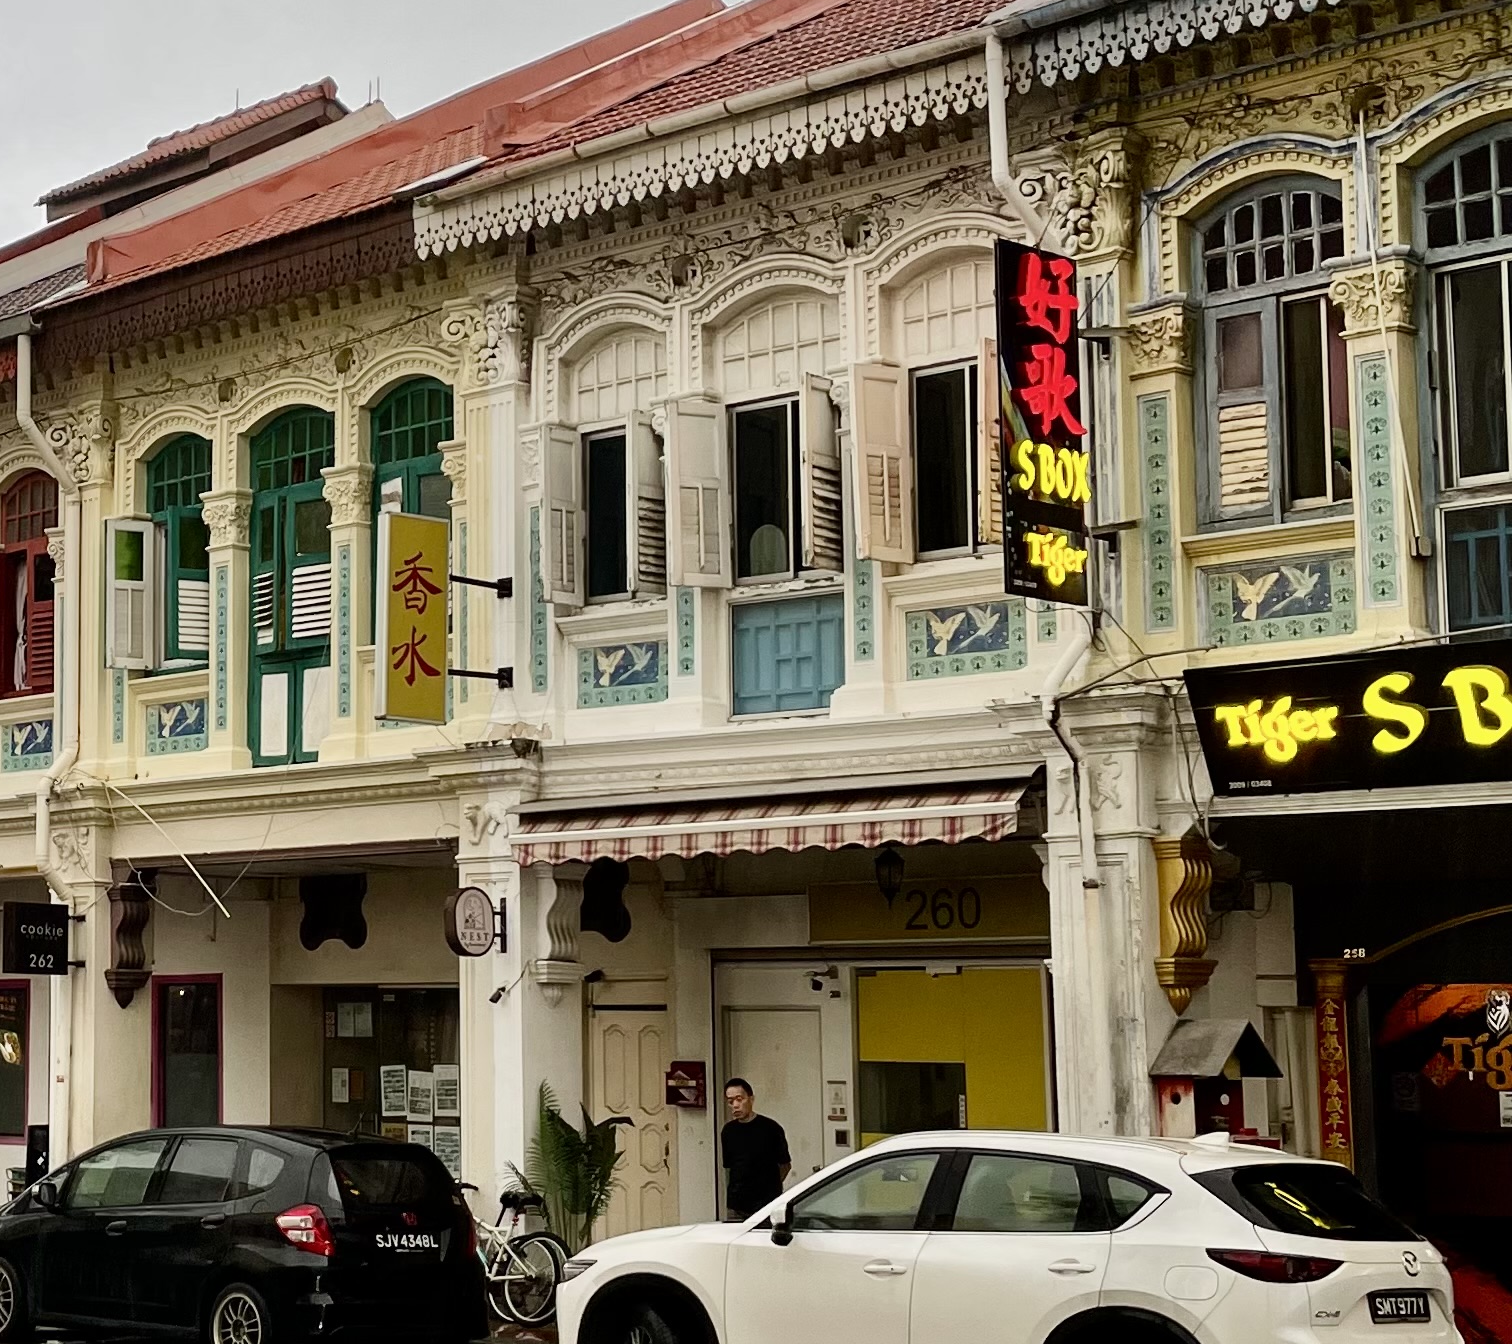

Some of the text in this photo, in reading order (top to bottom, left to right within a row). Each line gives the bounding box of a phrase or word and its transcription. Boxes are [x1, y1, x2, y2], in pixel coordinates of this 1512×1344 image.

[1019, 252, 1088, 436] 好歌
[1037, 443, 1092, 503] BOX
[1024, 532, 1088, 587] Tiger
[392, 551, 443, 687] 香水
[1215, 696, 1339, 763] Tiger
[1363, 672, 1429, 754] S
[20, 922, 64, 937] cookie
[905, 887, 981, 930] 260
[29, 953, 54, 969] 262
[460, 931, 489, 942] NEST
